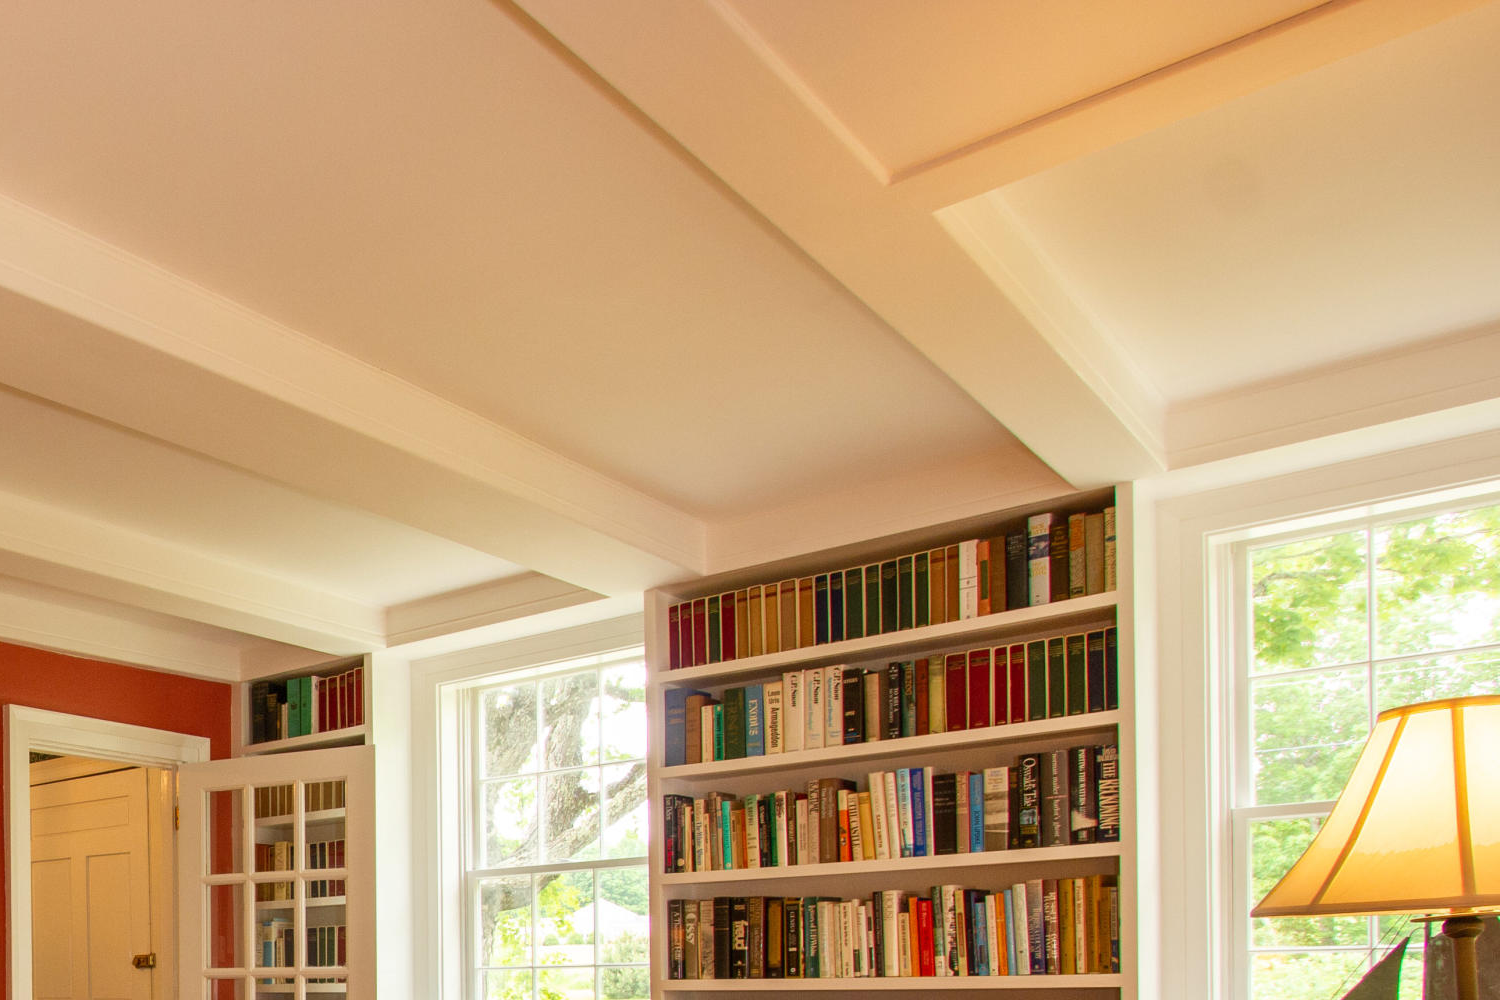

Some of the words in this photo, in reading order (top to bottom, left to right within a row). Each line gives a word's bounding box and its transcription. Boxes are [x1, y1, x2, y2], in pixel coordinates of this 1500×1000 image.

[748, 699, 759, 737] EXODUS
[769, 707, 781, 748] Armageddon
[1022, 757, 1037, 790] Oswald's
[1102, 761, 1116, 778] THE
[1023, 790, 1037, 807] Tale
[851, 820, 860, 848] CASTLE
[732, 920, 749, 950] freud
